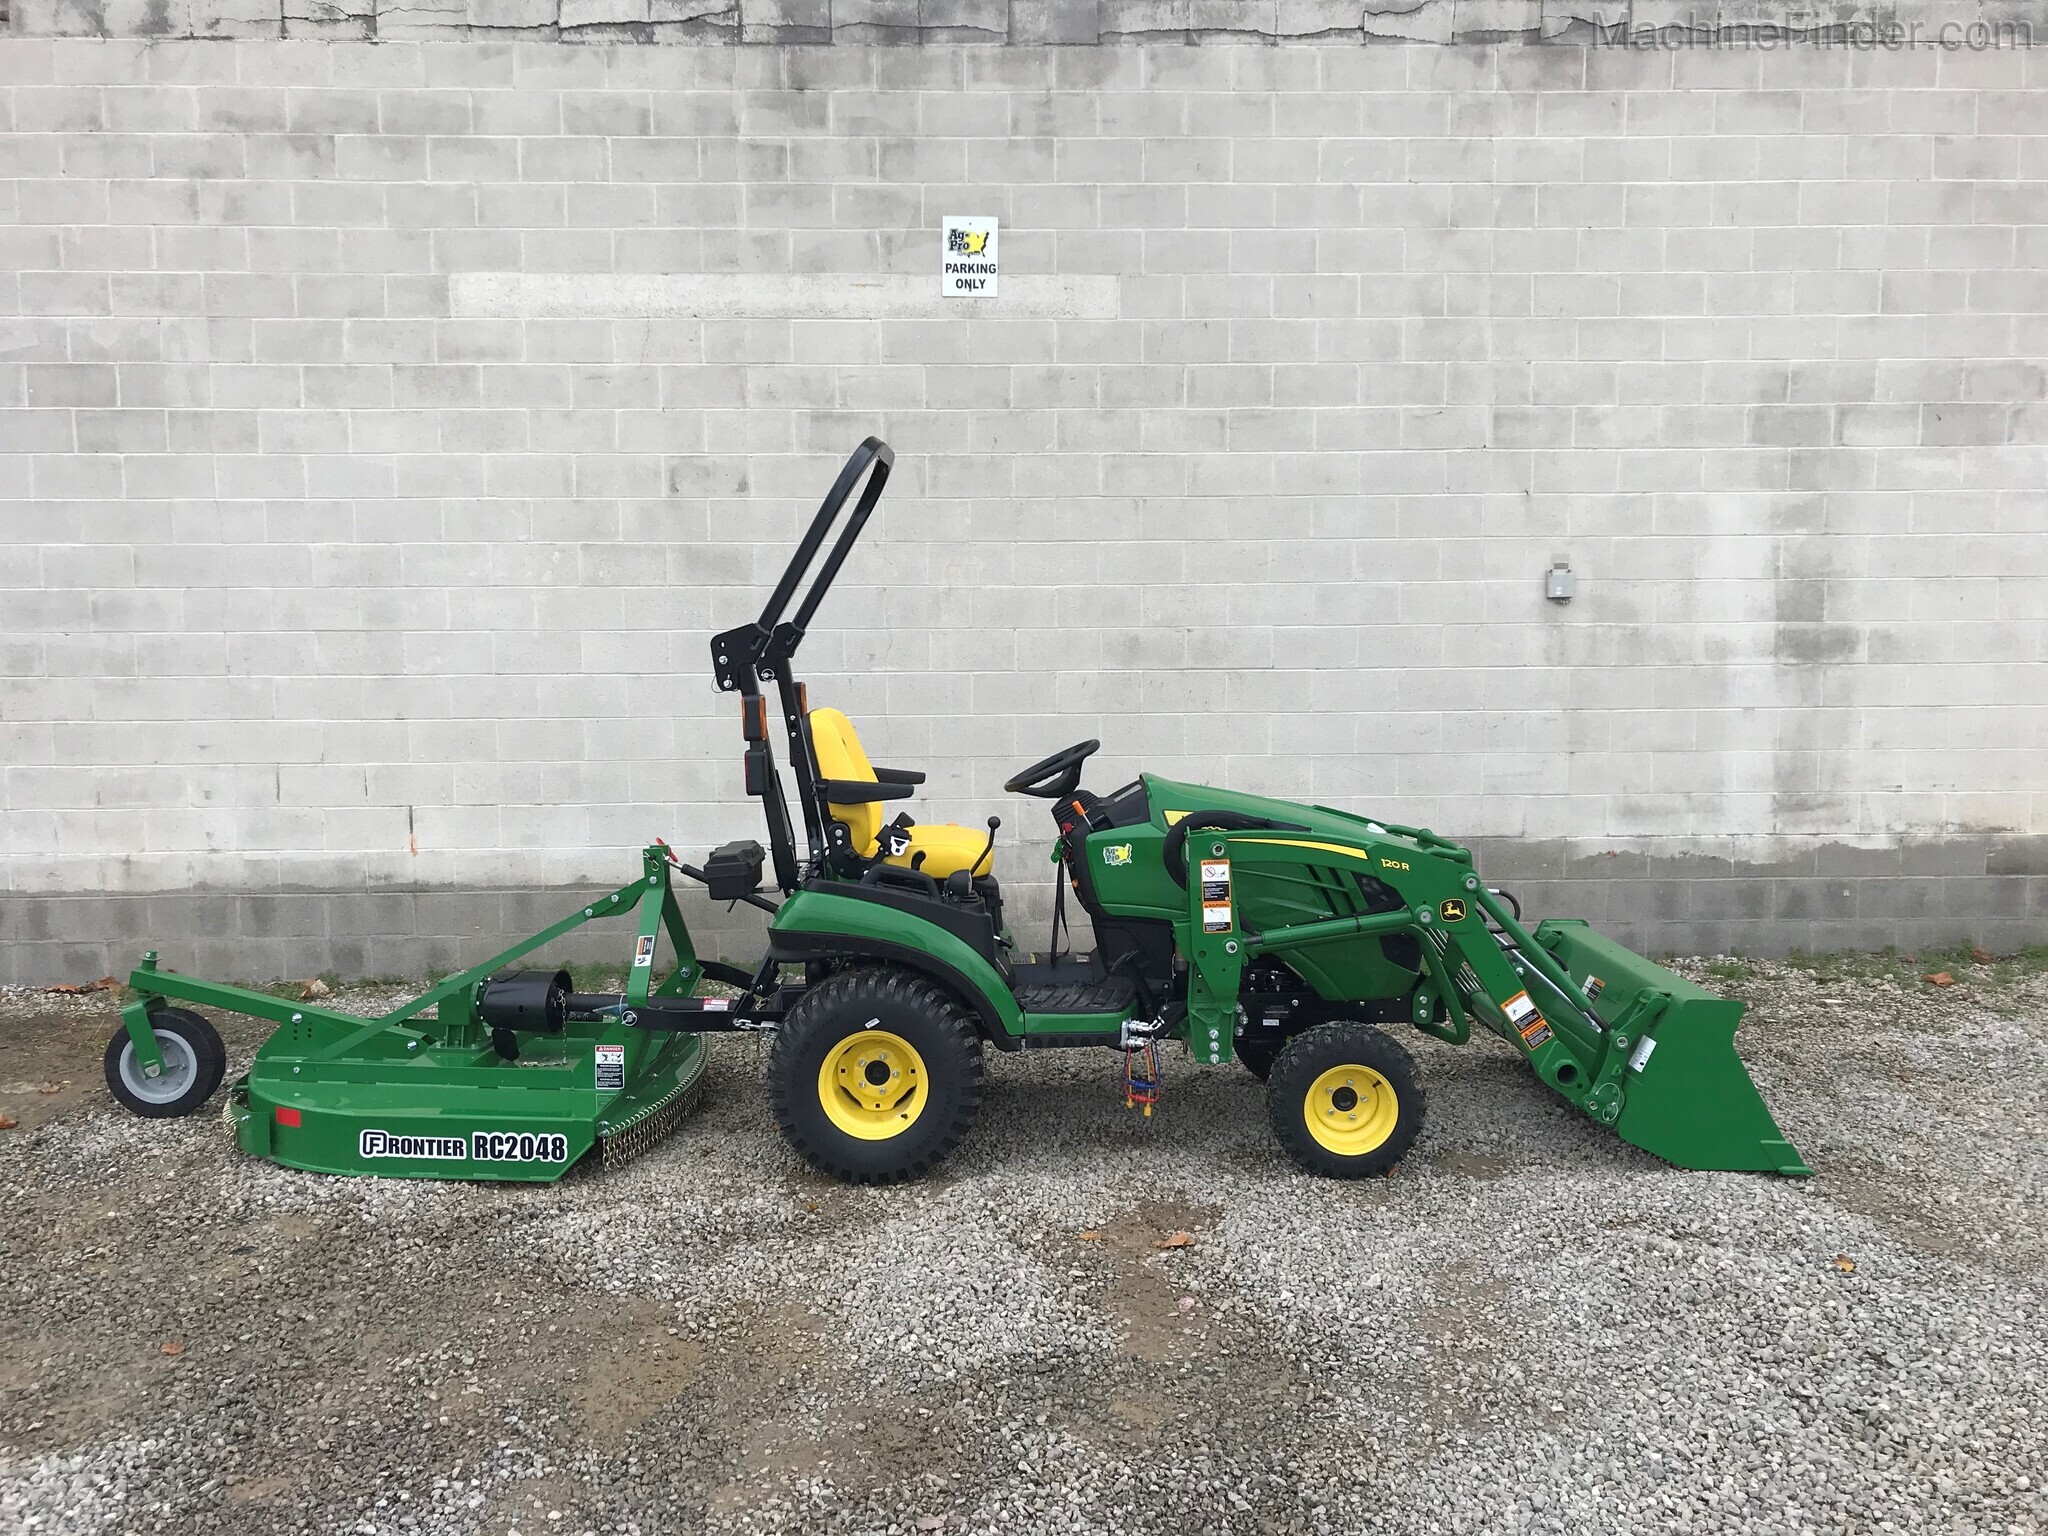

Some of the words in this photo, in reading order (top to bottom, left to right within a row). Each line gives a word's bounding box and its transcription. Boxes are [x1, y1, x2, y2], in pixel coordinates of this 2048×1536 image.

[949, 229, 969, 241] Ag-
[949, 240, 970, 251] Pro
[945, 263, 997, 274] PARKING
[955, 279, 986, 289] ONLY
[1401, 862, 1410, 871] R
[362, 1131, 464, 1157] FRONTIER
[474, 1134, 565, 1160] RC2048
